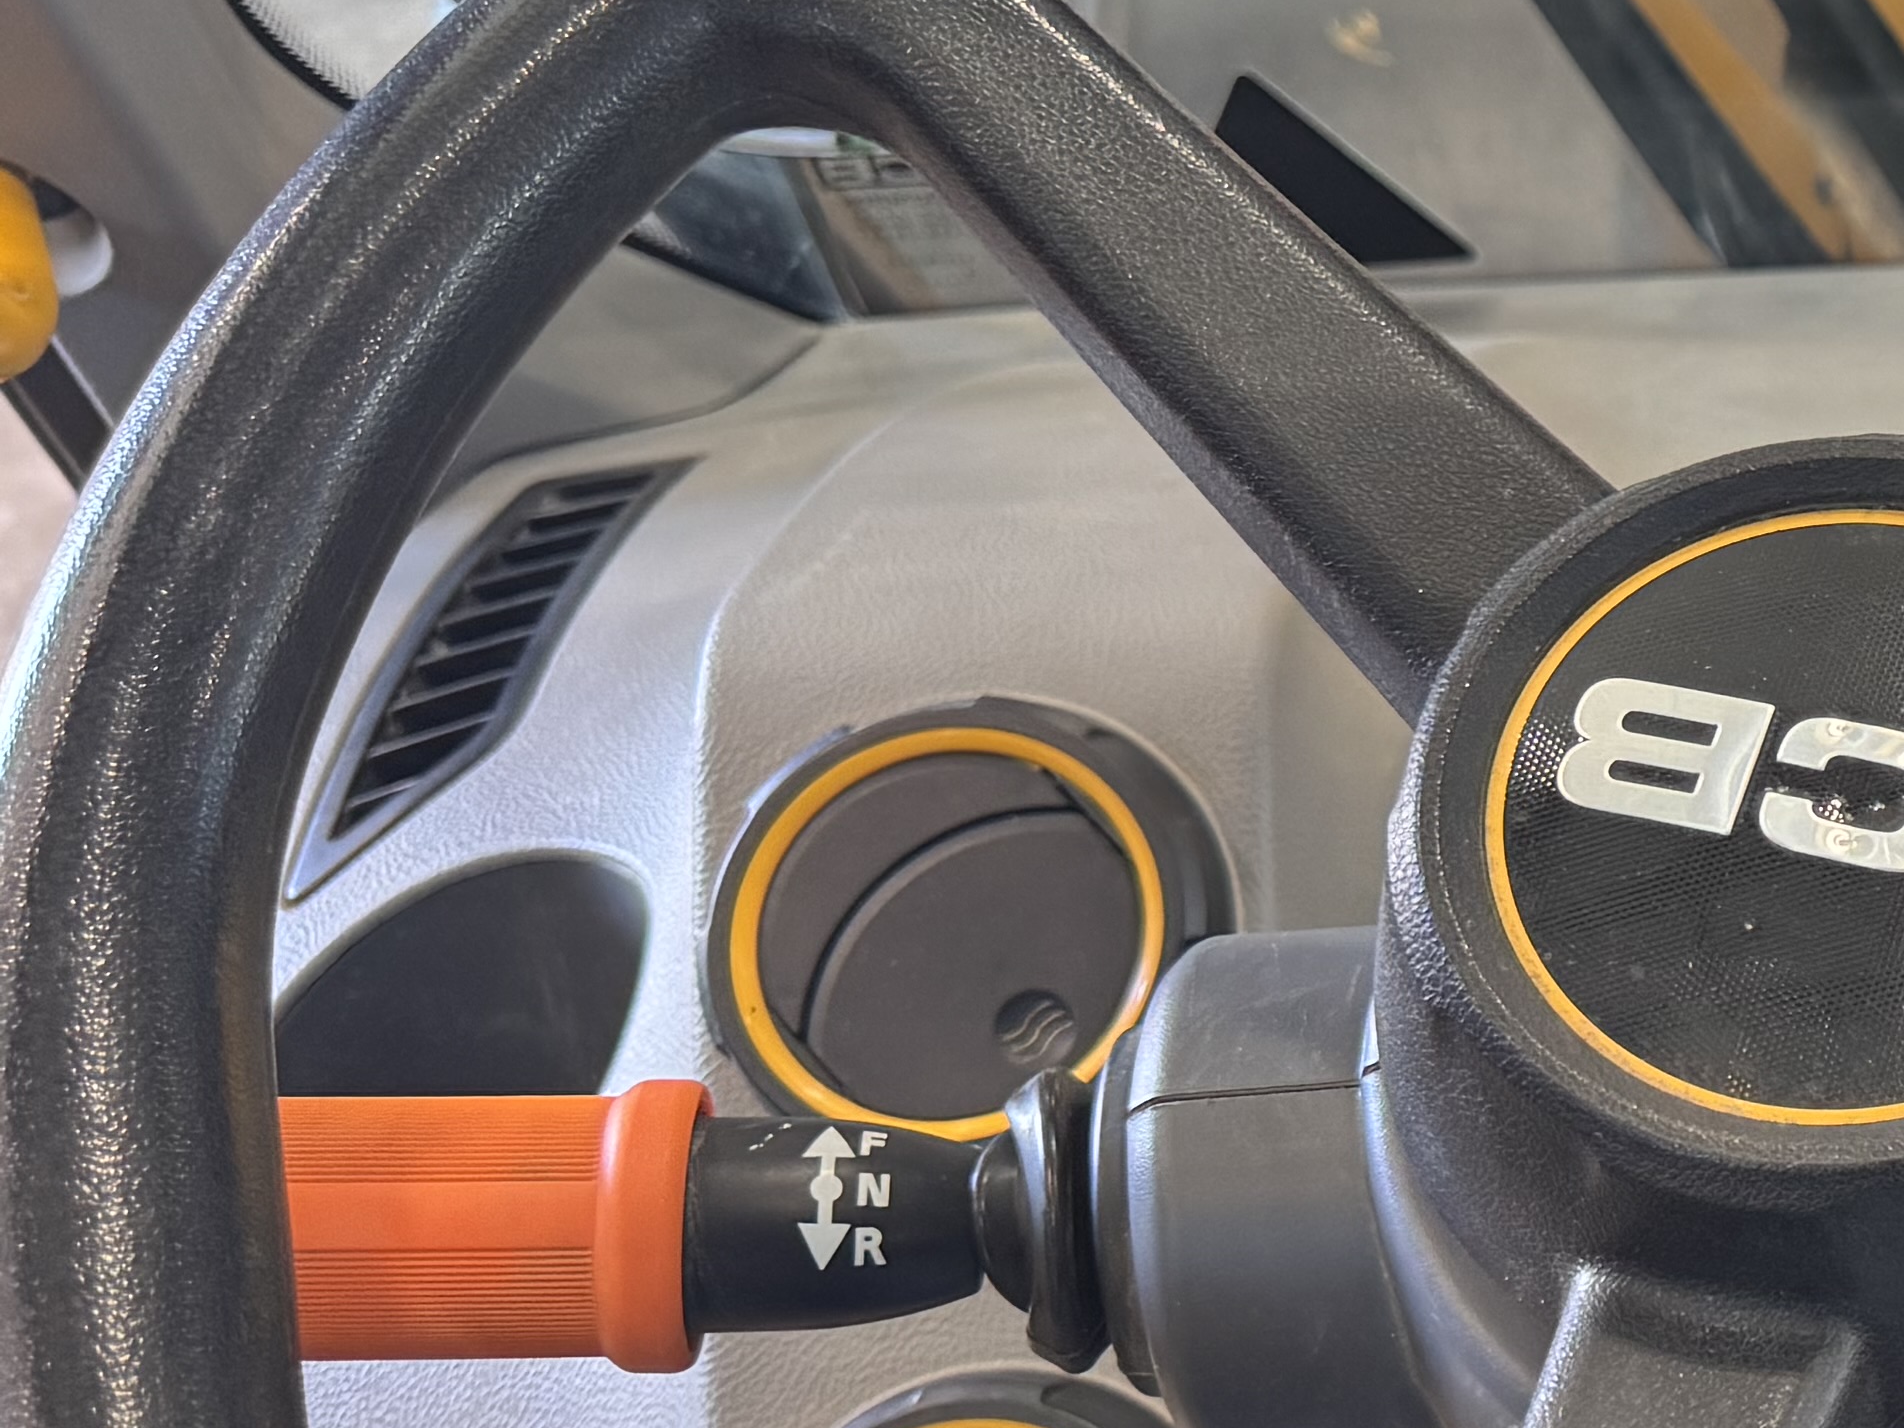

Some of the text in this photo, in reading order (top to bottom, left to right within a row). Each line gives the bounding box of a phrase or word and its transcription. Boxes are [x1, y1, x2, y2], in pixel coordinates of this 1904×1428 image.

[860, 1130, 889, 1156] F
[856, 1172, 891, 1208] N
[854, 1226, 887, 1266] R
